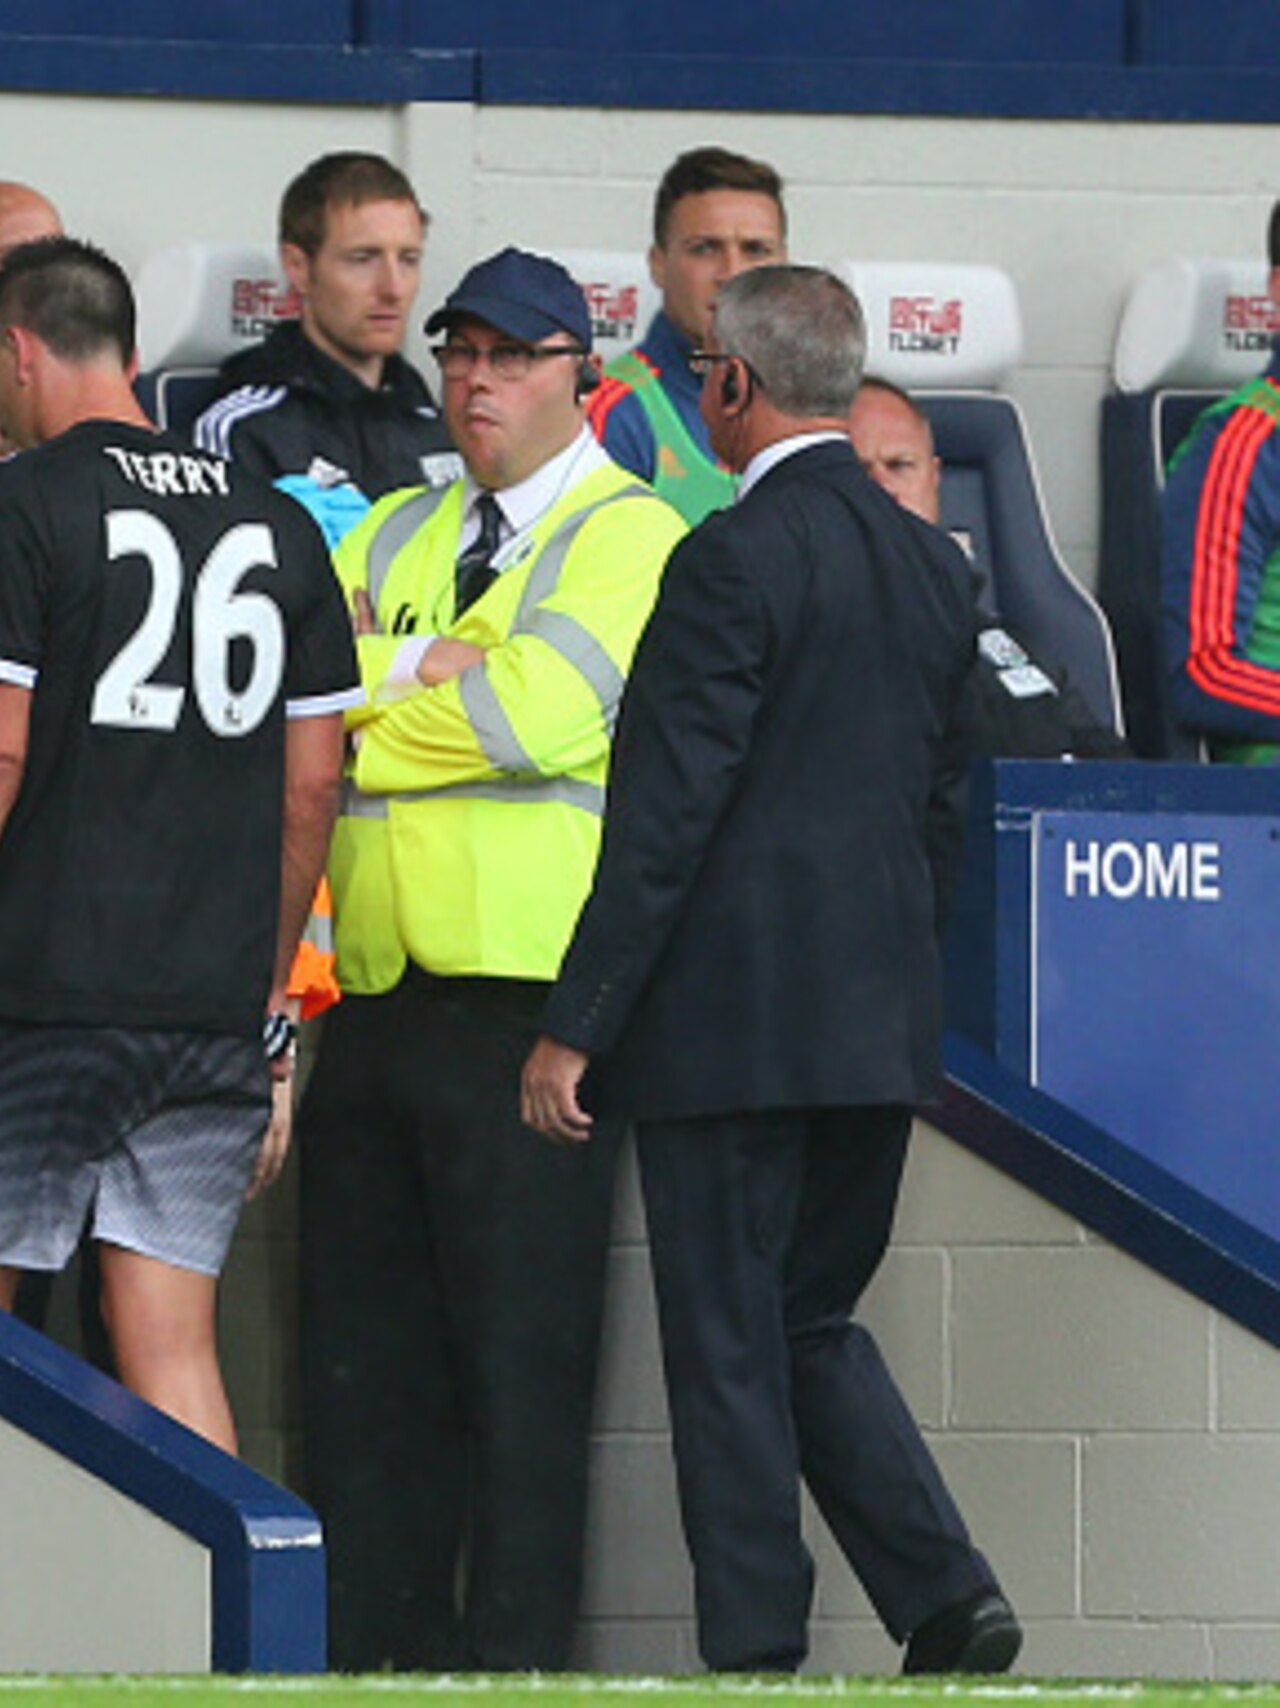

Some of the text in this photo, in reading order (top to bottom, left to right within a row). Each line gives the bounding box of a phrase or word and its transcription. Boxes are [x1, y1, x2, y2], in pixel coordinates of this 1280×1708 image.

[103, 447, 230, 496] TERRY
[90, 508, 286, 737] 26
[1064, 840, 1220, 899] HOME
